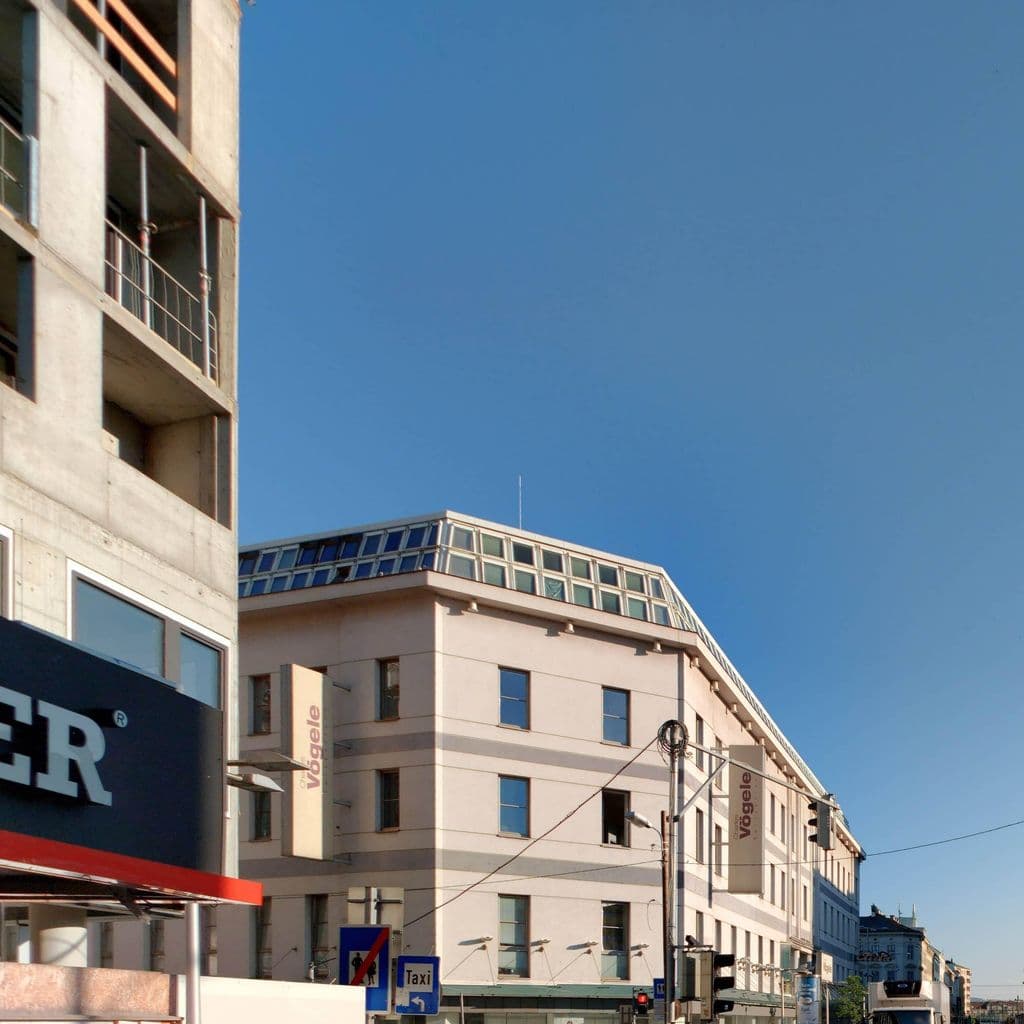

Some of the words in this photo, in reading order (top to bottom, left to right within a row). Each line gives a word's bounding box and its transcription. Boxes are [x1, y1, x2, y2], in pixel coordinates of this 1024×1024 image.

[306, 705, 322, 789] Vögele
[739, 771, 754, 839] Vögele
[406, 969, 431, 985] Taxi
